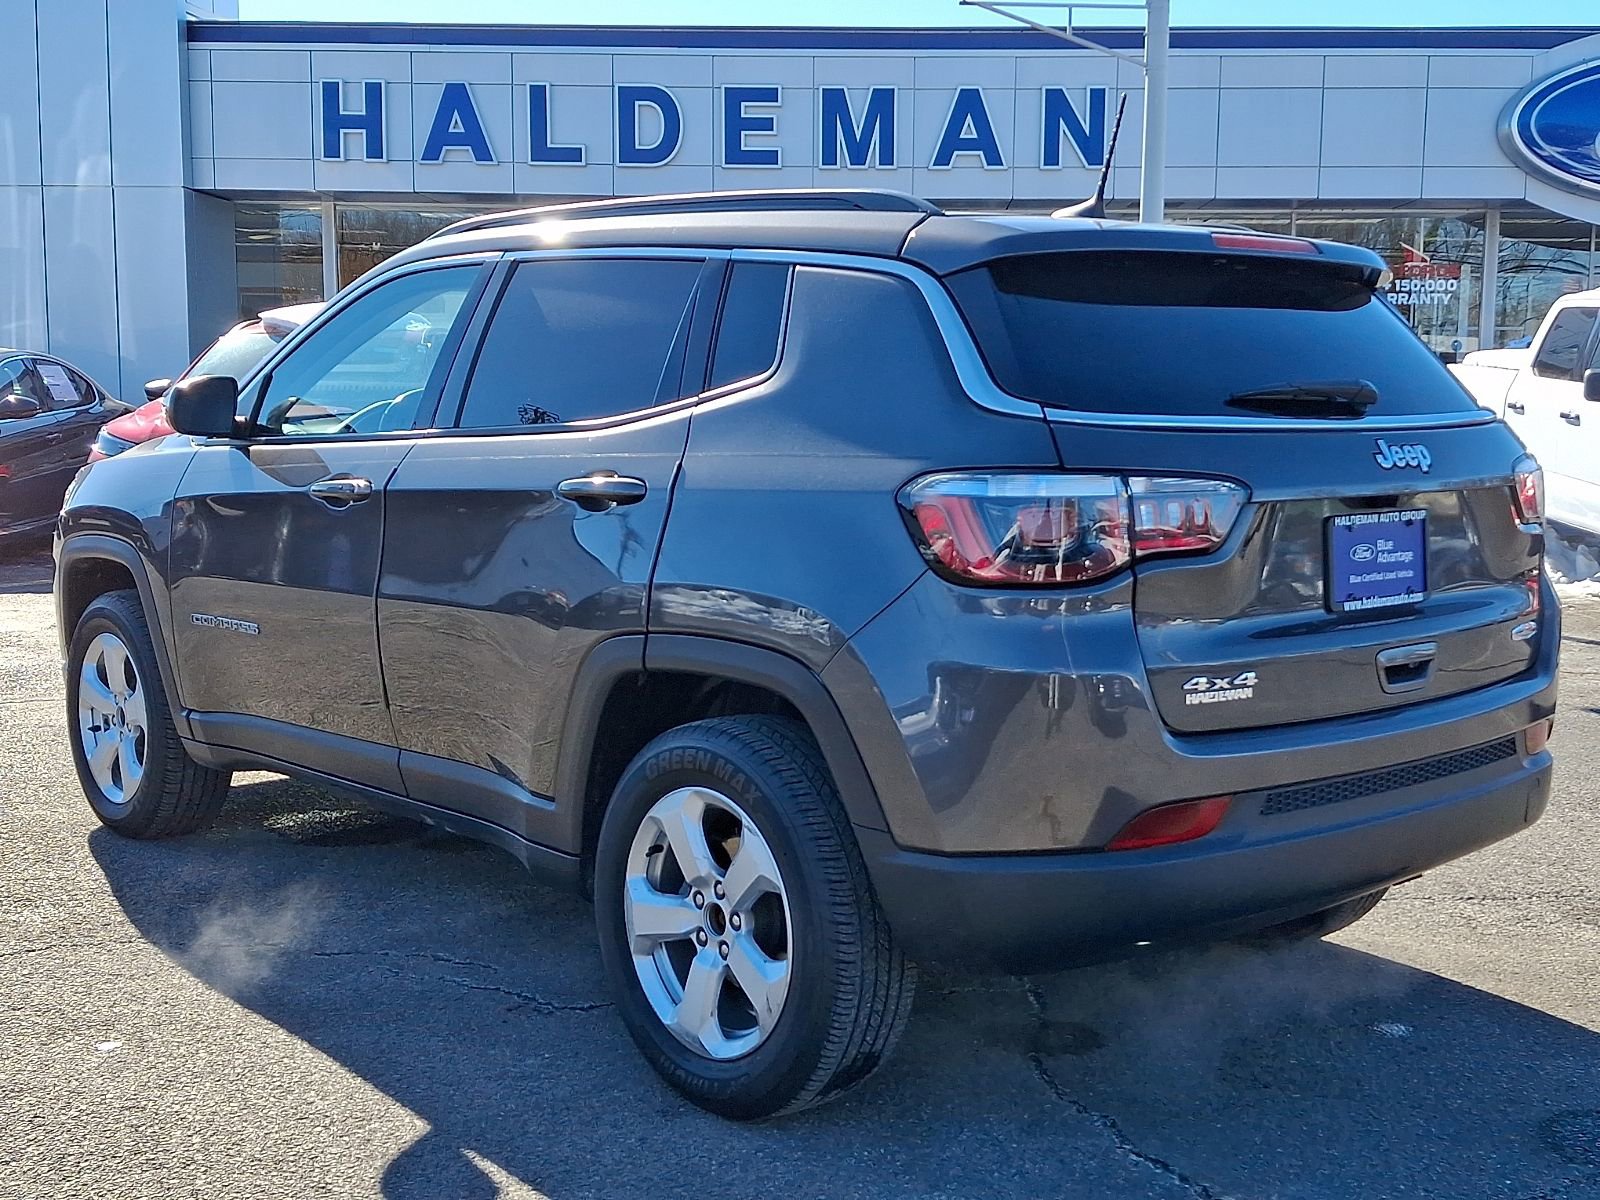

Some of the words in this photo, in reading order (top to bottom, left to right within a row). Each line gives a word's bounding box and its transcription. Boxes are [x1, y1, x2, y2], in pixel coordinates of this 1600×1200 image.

[319, 78, 1109, 170] HALDEMAN
[1394, 279, 1457, 292] 150,000
[1386, 293, 1452, 305] RRANTY
[1375, 439, 1431, 472] Jeep
[1334, 514, 1378, 526] HALDEMAN
[1379, 512, 1400, 522] AUTO
[1400, 510, 1427, 520] GROUP
[1376, 540, 1395, 551] Blue
[1376, 551, 1414, 563] Advantage
[1182, 671, 1259, 691] 4x4
[646, 748, 711, 780] GREEN
[713, 755, 762, 804] MAX
